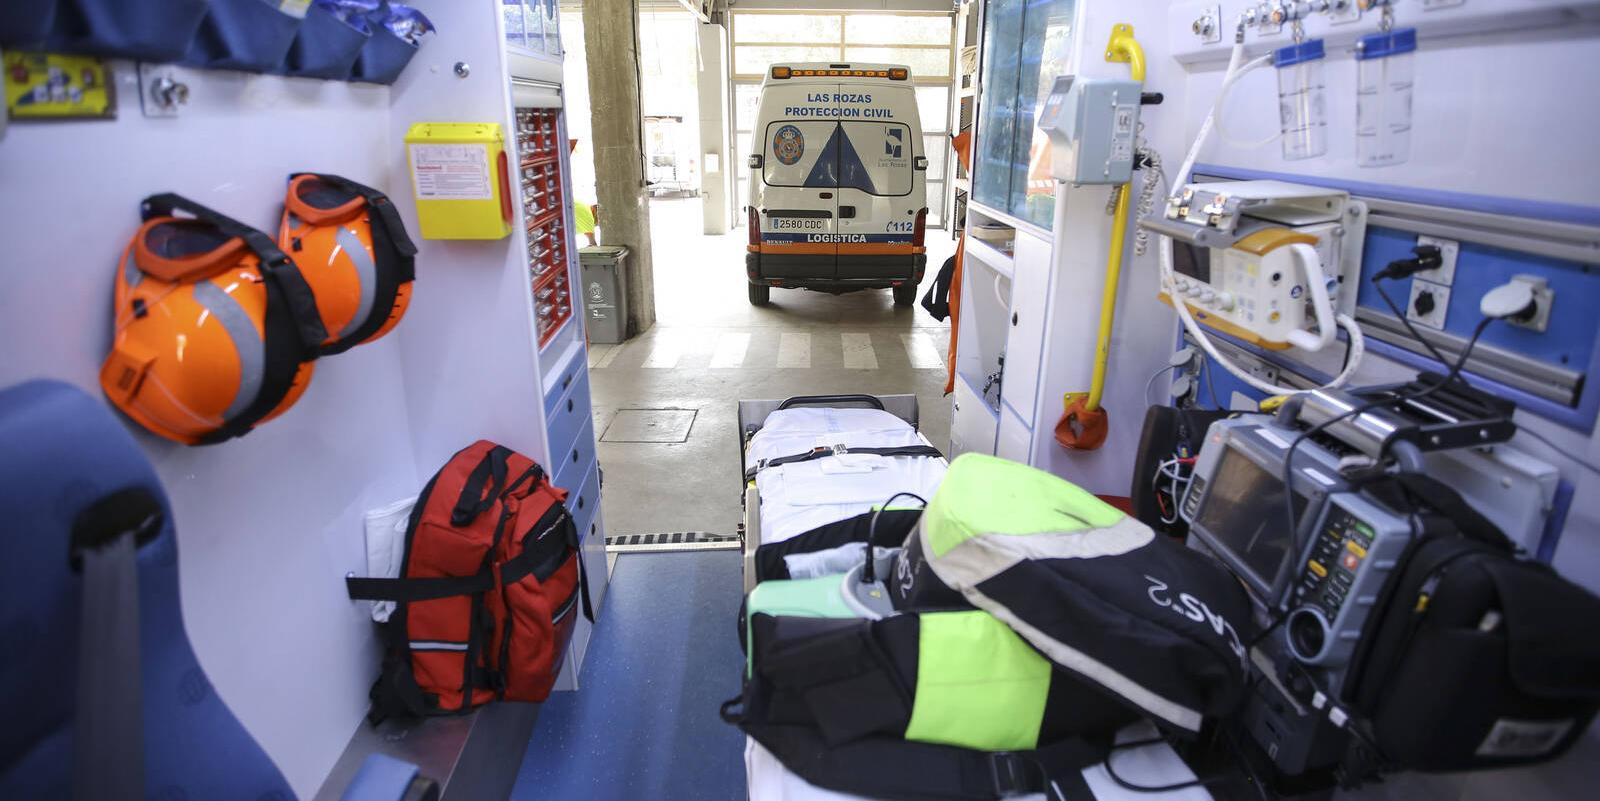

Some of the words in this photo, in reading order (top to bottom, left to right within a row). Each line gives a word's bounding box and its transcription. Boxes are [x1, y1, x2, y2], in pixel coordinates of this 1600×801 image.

[807, 93, 830, 103] LAS
[832, 93, 872, 104] ROZAS
[785, 106, 860, 118] PROTECCION
[863, 108, 894, 118] CIVIL
[780, 219, 803, 229] 2580
[804, 220, 822, 229] CDC
[893, 221, 913, 232] 112
[807, 233, 867, 243] LOGISTICA
